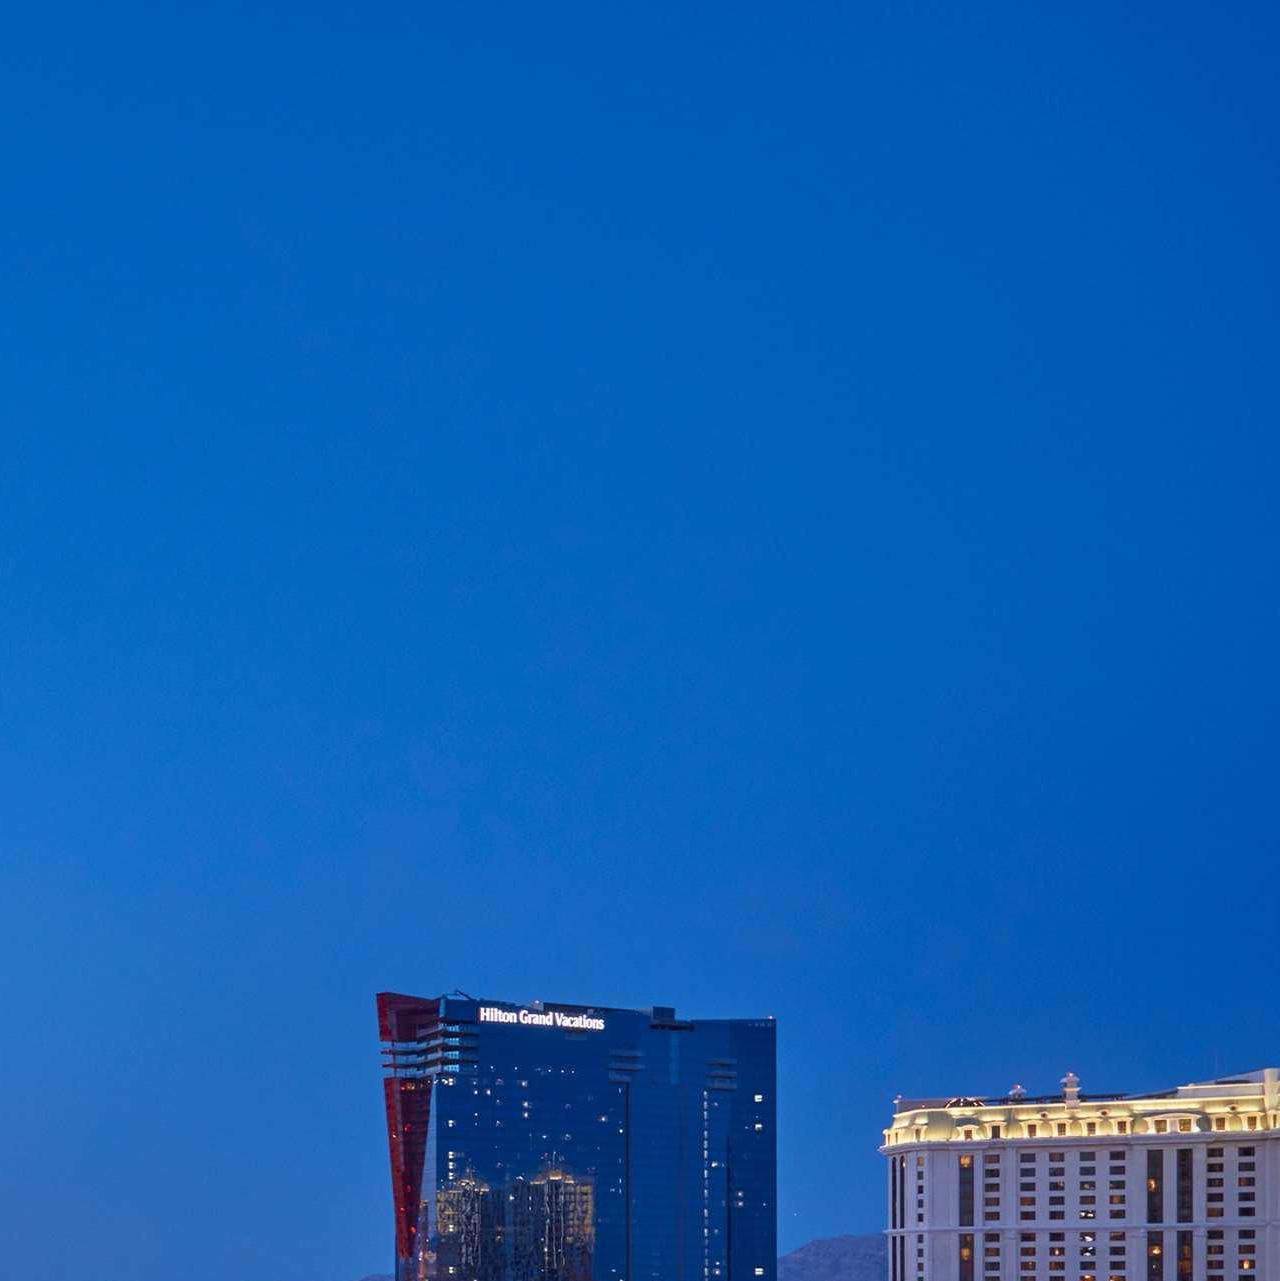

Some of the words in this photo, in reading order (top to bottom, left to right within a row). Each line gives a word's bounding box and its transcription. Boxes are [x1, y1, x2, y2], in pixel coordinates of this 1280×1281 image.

[479, 1006, 517, 1024] Hilton
[519, 1009, 553, 1028] Grand
[554, 1012, 605, 1030] Vacations
